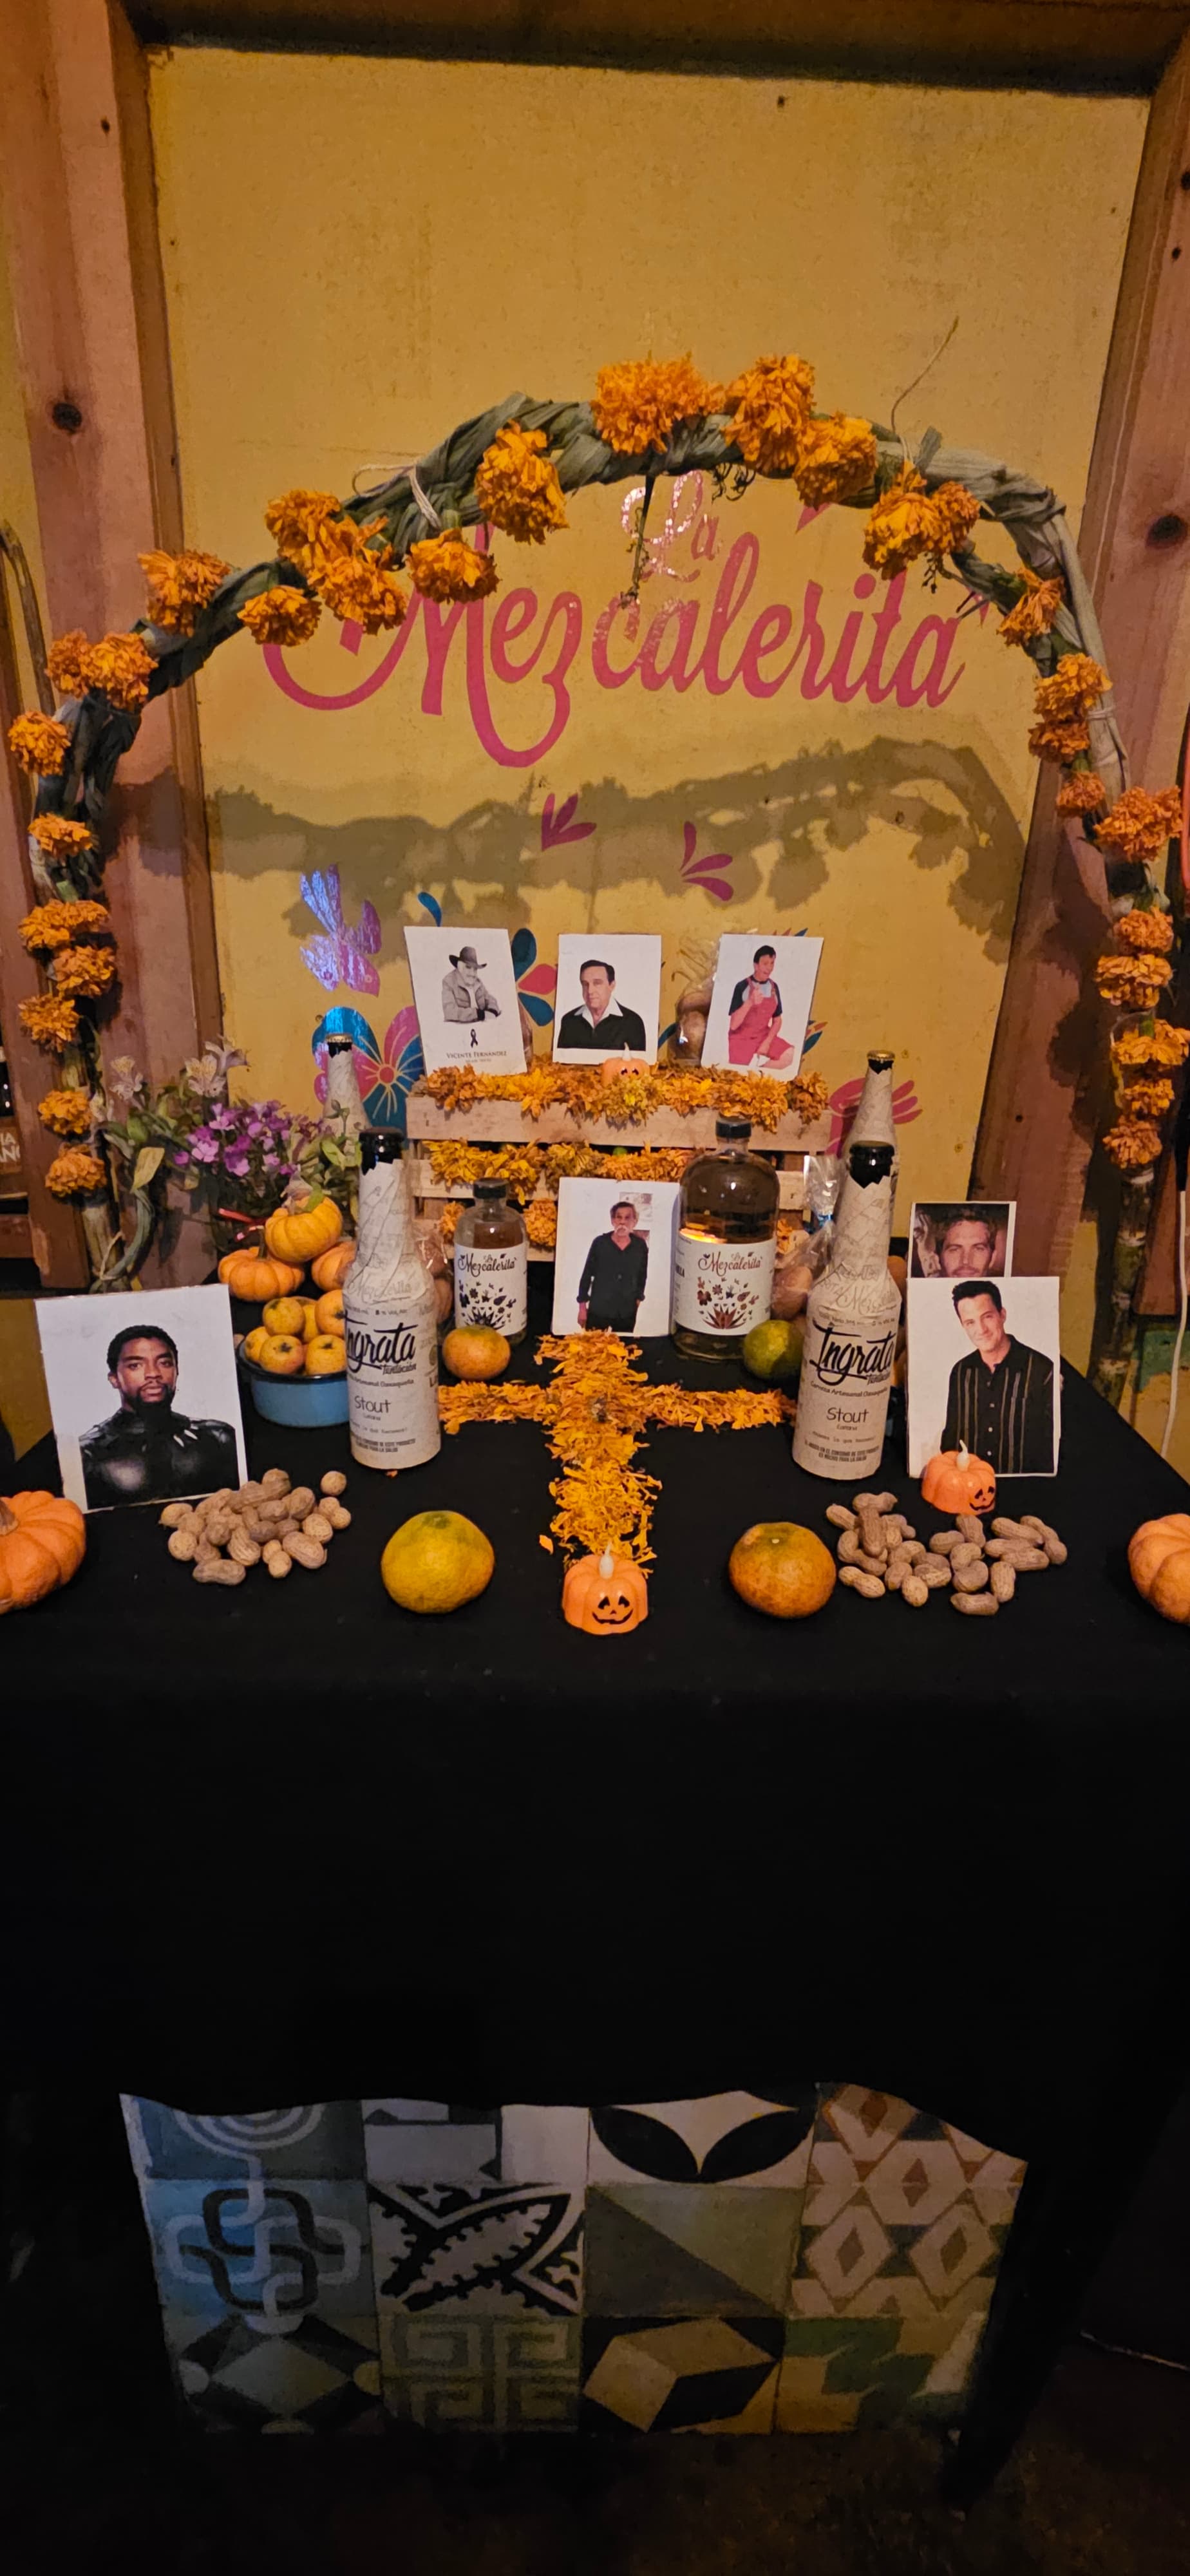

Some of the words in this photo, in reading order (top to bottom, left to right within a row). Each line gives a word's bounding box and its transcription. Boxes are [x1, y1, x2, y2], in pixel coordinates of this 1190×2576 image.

[621, 469, 719, 583] La
[263, 524, 967, 768] Mezcalerita
[457, 1253, 516, 1278] Mezcalerita
[697, 1251, 762, 1277] Mezcalerita
[809, 1317, 896, 1386] Ingrata
[354, 1395, 392, 1414] Stout
[826, 1406, 869, 1423] Stout
